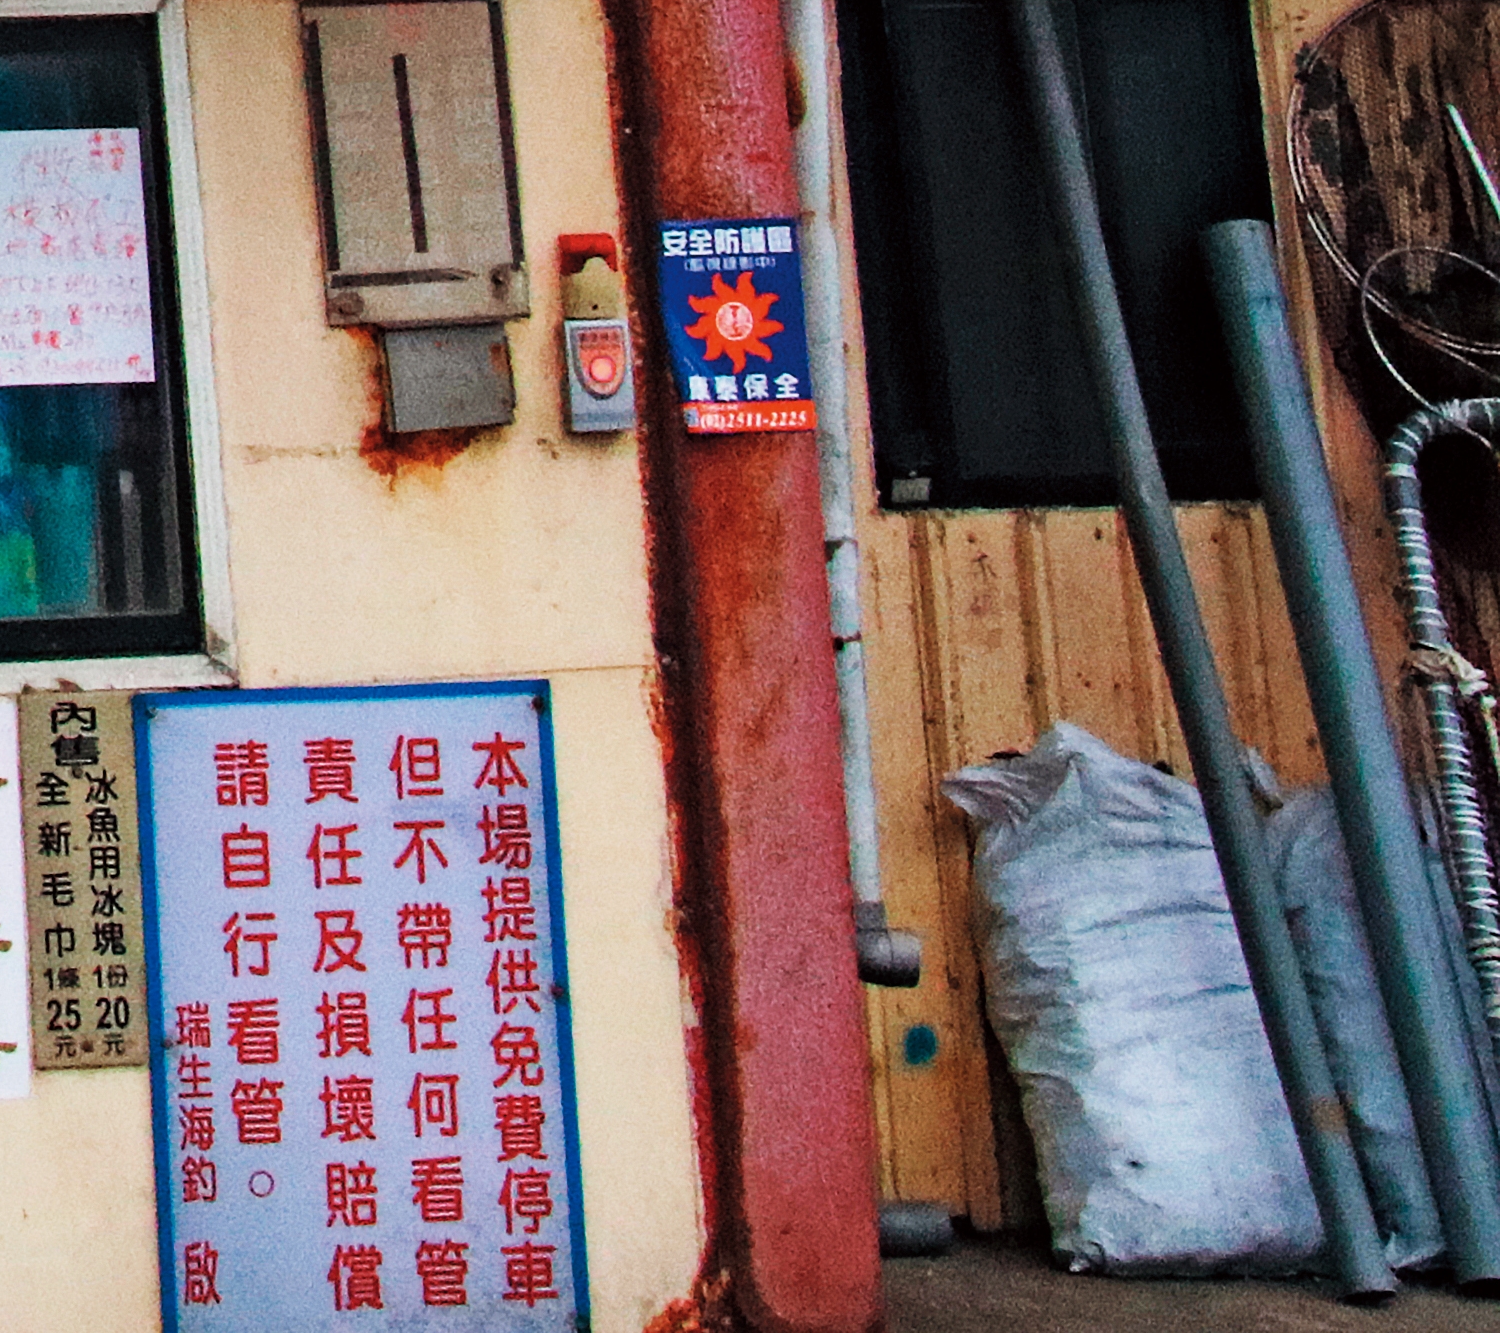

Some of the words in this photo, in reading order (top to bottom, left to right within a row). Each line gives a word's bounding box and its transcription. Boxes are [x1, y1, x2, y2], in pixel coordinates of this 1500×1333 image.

[662, 225, 793, 257] 安全防護區
[174, 1000, 218, 1205] 瑞生海釣
[302, 735, 385, 1313] 責任及損壞賠償
[388, 733, 470, 1310] 但不帶任何看管
[471, 730, 560, 1308] 本場提供免費停車
